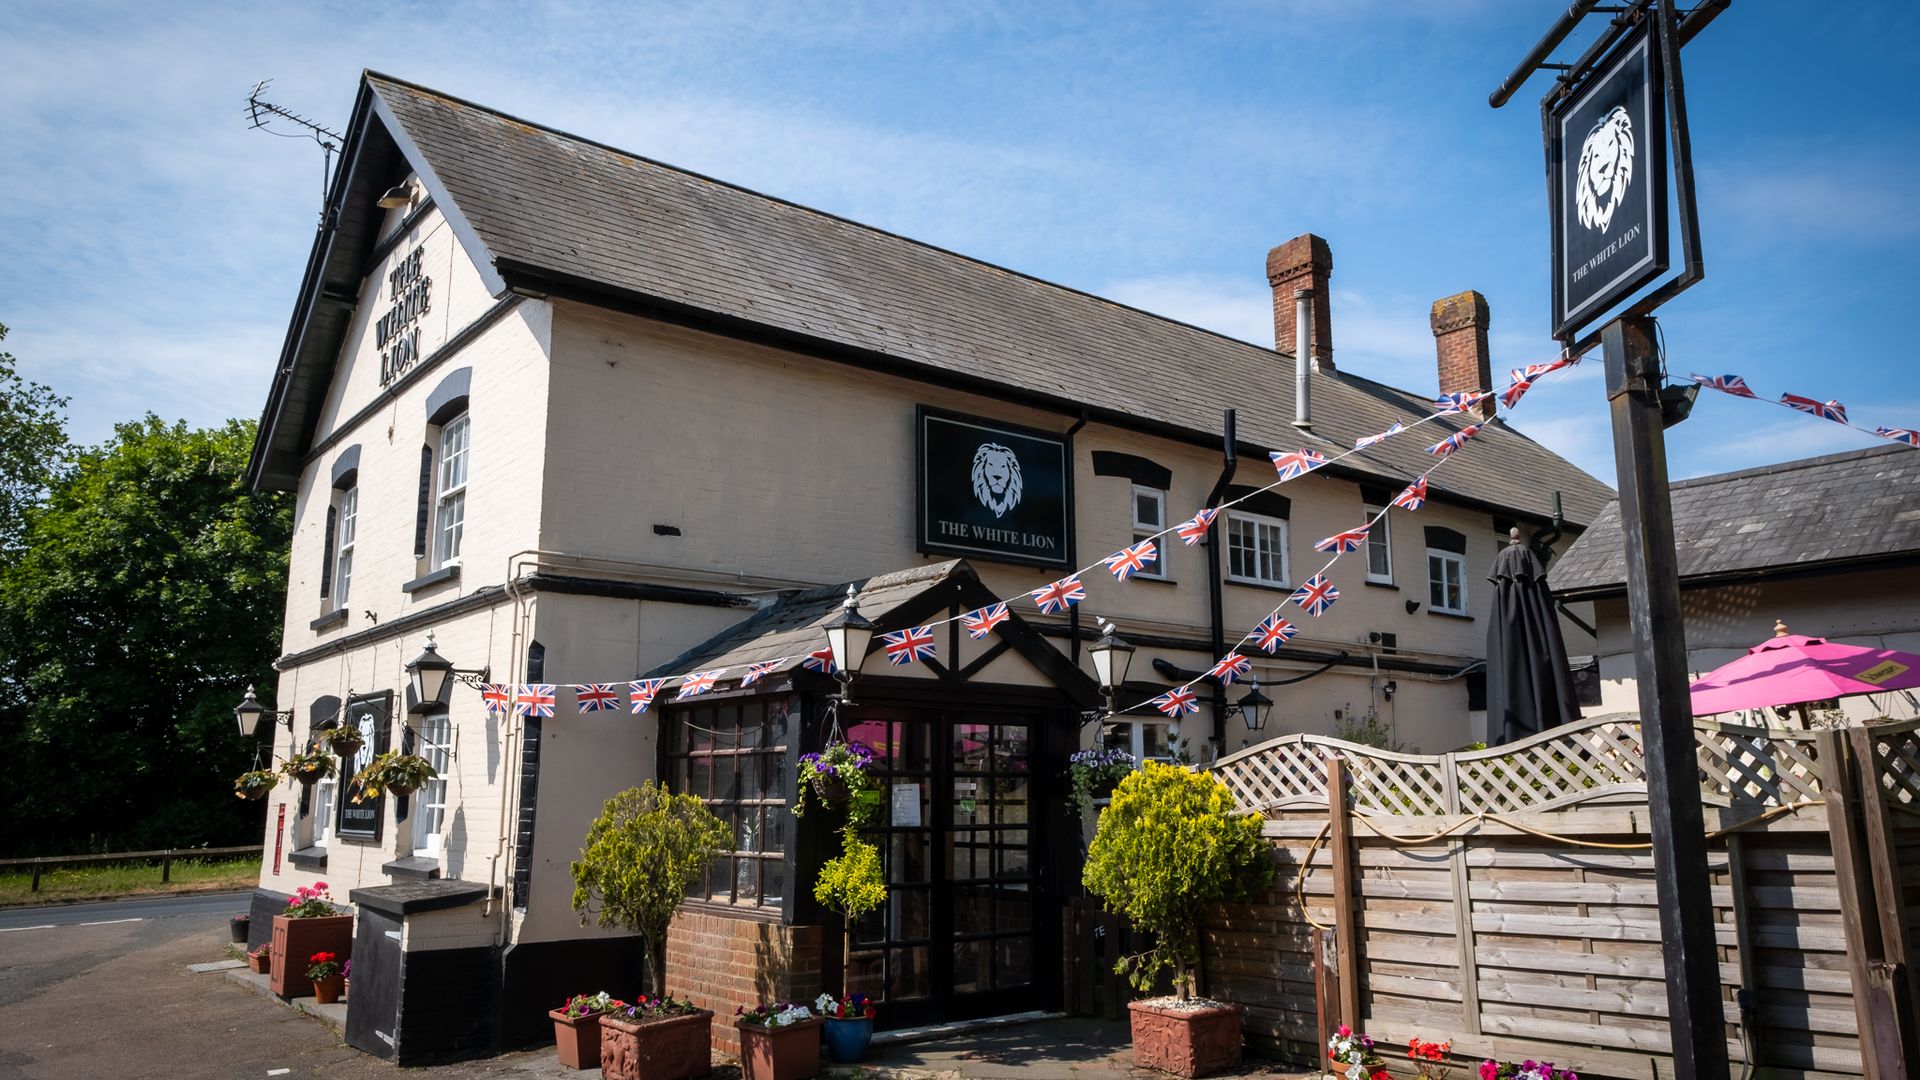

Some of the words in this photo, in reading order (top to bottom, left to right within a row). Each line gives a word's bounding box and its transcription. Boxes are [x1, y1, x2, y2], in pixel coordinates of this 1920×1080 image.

[389, 244, 424, 302] THE
[1572, 263, 1588, 283] THE
[1589, 241, 1617, 269] WHITE
[1618, 223, 1640, 248] LION
[376, 275, 432, 351] WHITE
[379, 326, 421, 387] LION
[939, 520, 969, 537] THE
[972, 525, 1019, 545] WHITE
[1023, 533, 1055, 550] LION
